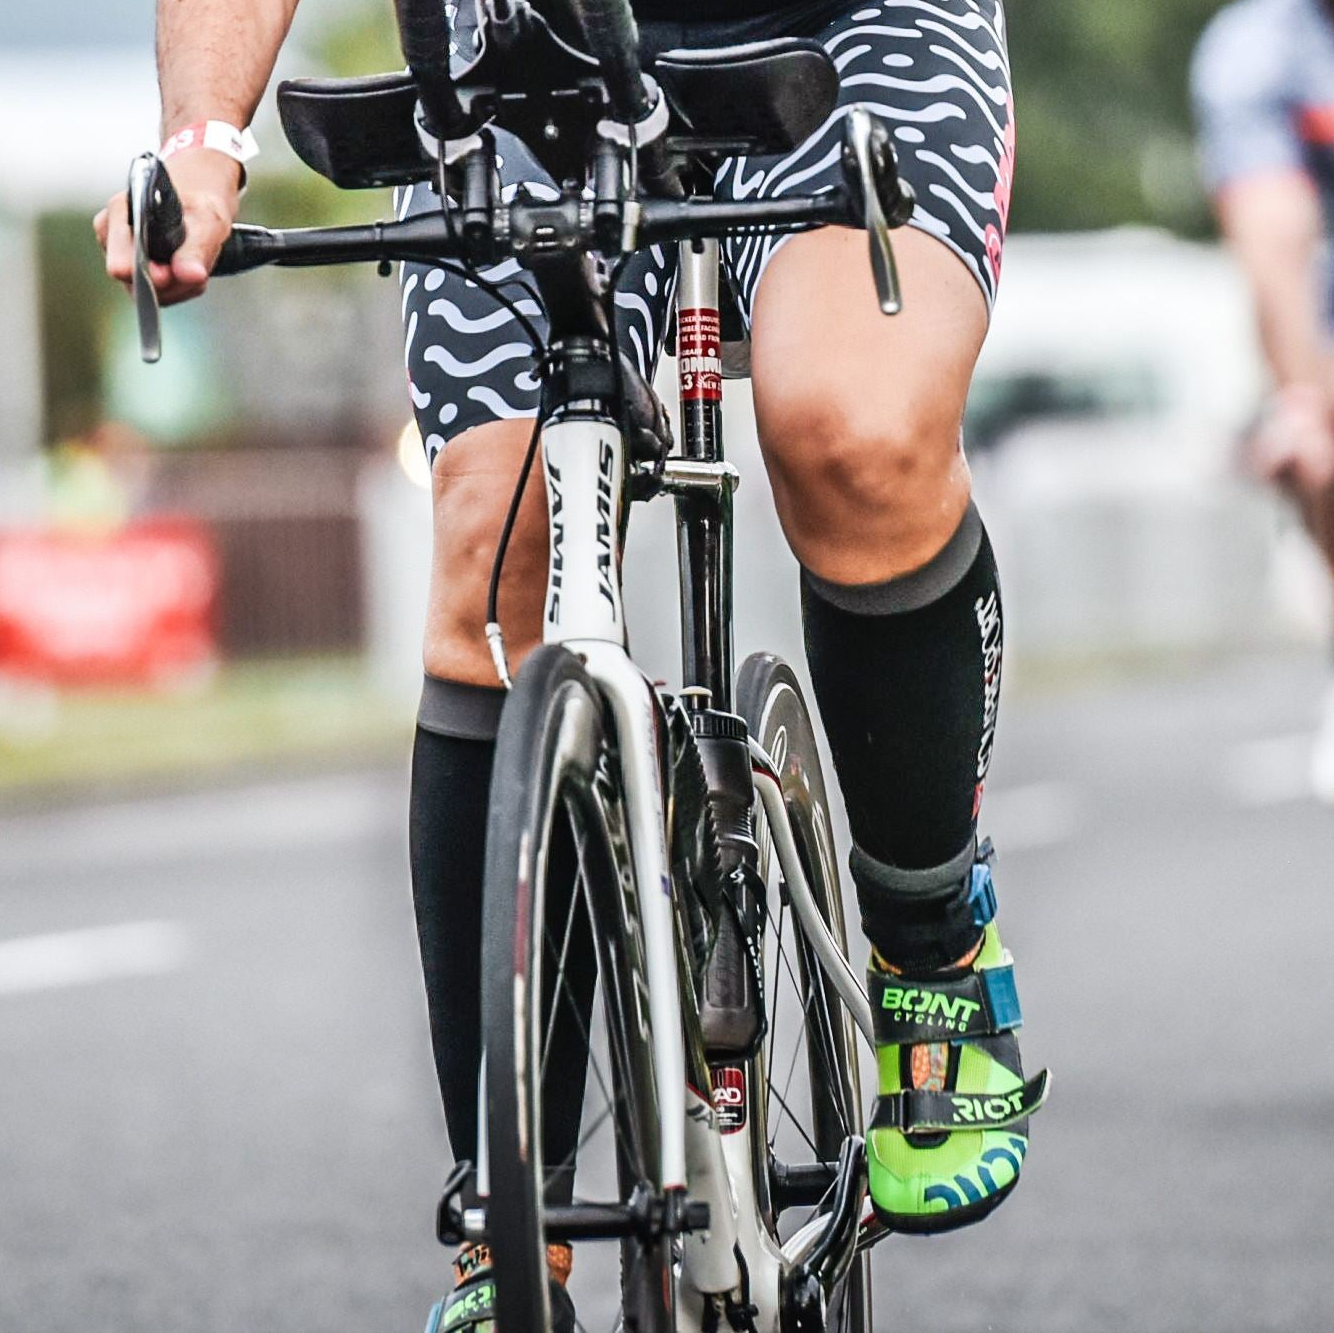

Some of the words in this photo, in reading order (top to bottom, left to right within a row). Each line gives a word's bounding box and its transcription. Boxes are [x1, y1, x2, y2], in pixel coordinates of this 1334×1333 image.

[545, 445, 564, 626] JAMIS
[596, 439, 617, 623] JAMIS
[882, 987, 980, 1023] BONT
[894, 1012, 969, 1033] CYCLING
[951, 1091, 1024, 1123] RIOT
